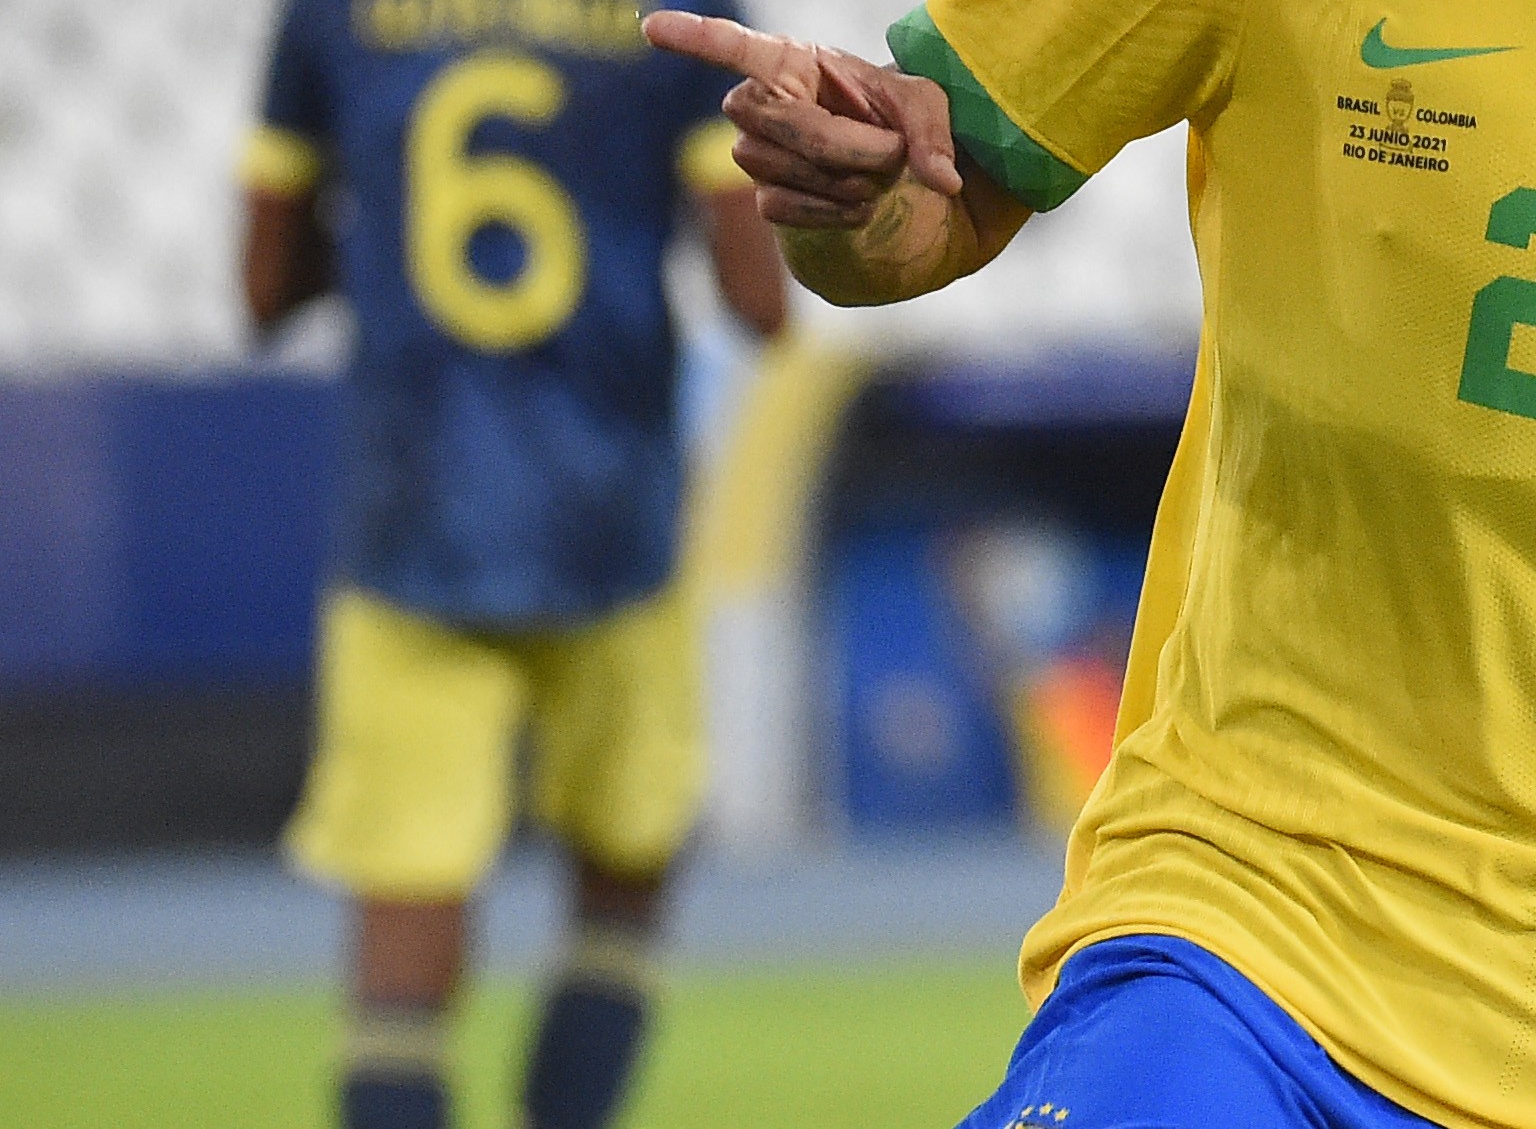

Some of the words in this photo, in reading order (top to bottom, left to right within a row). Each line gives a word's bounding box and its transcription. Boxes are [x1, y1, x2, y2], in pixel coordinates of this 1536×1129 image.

[1337, 95, 1381, 115] BRASIL
[1416, 108, 1477, 128] COLOMBIA
[1349, 125, 1365, 139] 23
[1367, 128, 1410, 147] JUNIO
[1413, 135, 1447, 152] 2021
[1343, 143, 1365, 159] RIO
[1368, 148, 1386, 163] DE
[1388, 152, 1449, 172] JANEIRO
[409, 53, 586, 351] 6
